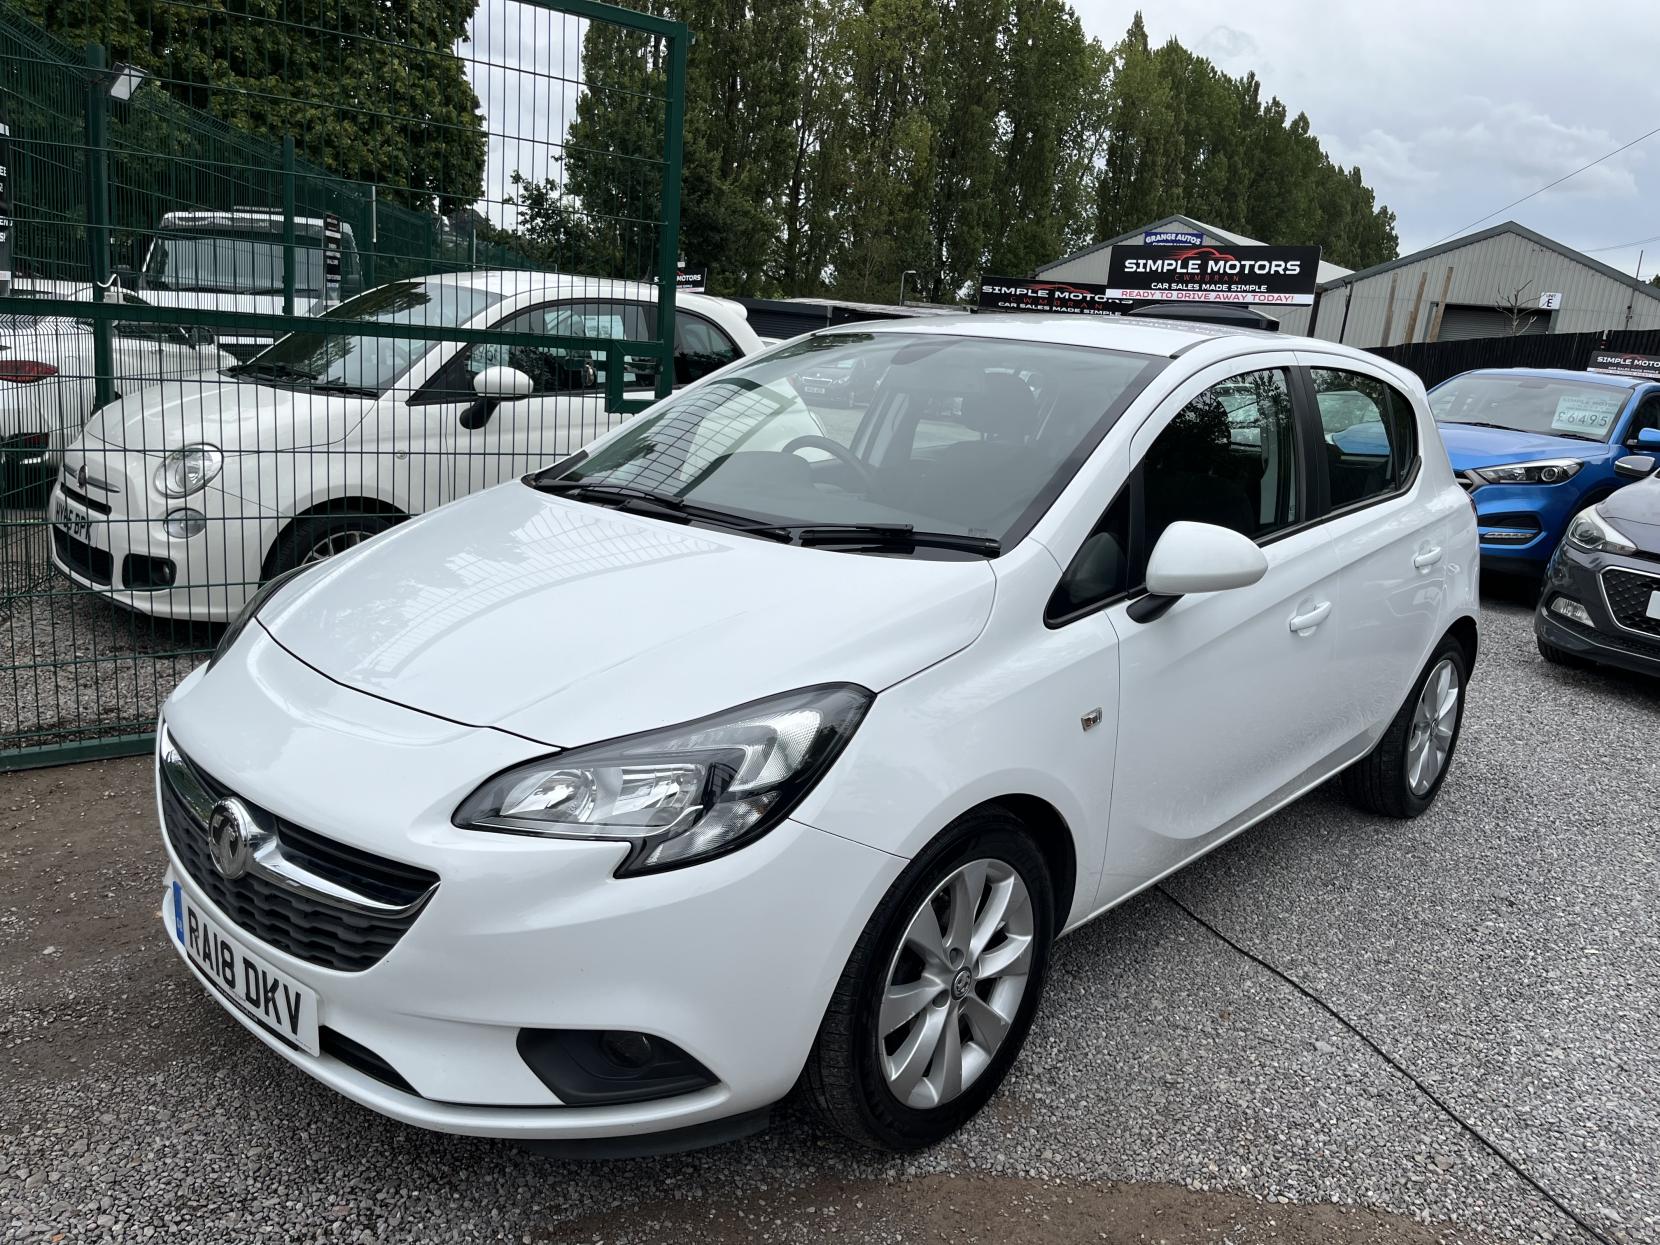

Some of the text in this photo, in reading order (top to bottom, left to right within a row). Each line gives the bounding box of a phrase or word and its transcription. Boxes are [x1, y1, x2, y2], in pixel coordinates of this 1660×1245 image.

[1145, 233, 1202, 245] GRANGE AUTOS
[1124, 259, 1301, 275] SIMPLE MOTORS
[982, 285, 1049, 298] SIMPLE
[1151, 282, 1169, 290] CAR
[1171, 283, 1200, 291] SALES
[1010, 296, 1104, 309] CWMBRAN
[1121, 290, 1295, 303] READY TO DRIVE AWAY TODAY!
[1547, 298, 1553, 308] E
[1020, 303, 1050, 311] SALES
[1597, 356, 1632, 365] SIMPLE
[1556, 411, 1609, 427] £6495
[187, 906, 236, 989] RA18
[243, 955, 301, 1036] DKV
